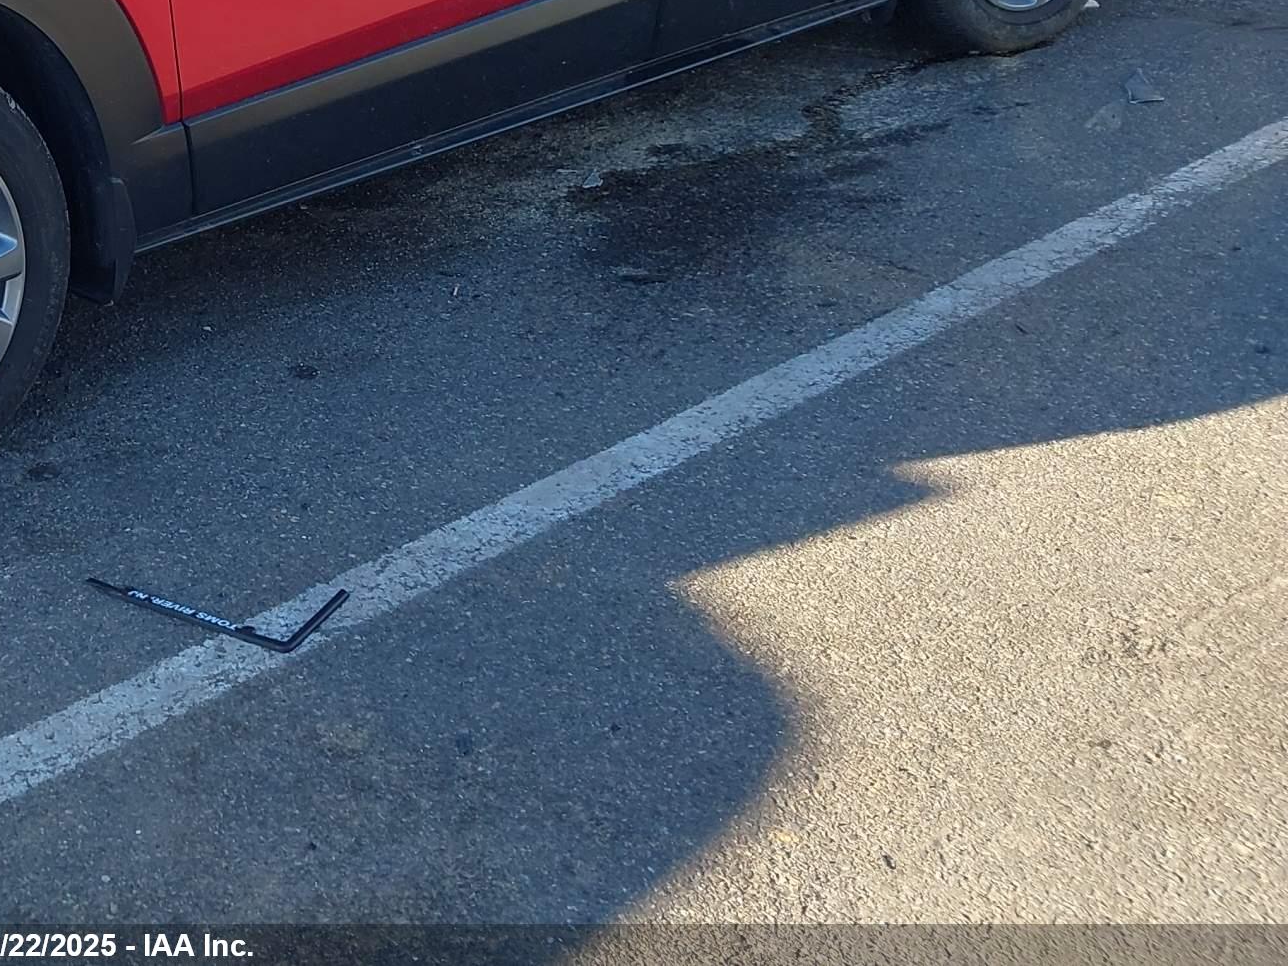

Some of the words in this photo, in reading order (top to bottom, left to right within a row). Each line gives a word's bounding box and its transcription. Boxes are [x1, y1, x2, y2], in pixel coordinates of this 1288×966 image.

[128, 589, 148, 600] NJ
[150, 596, 196, 615] RIVER,
[196, 611, 237, 631] TOMS
